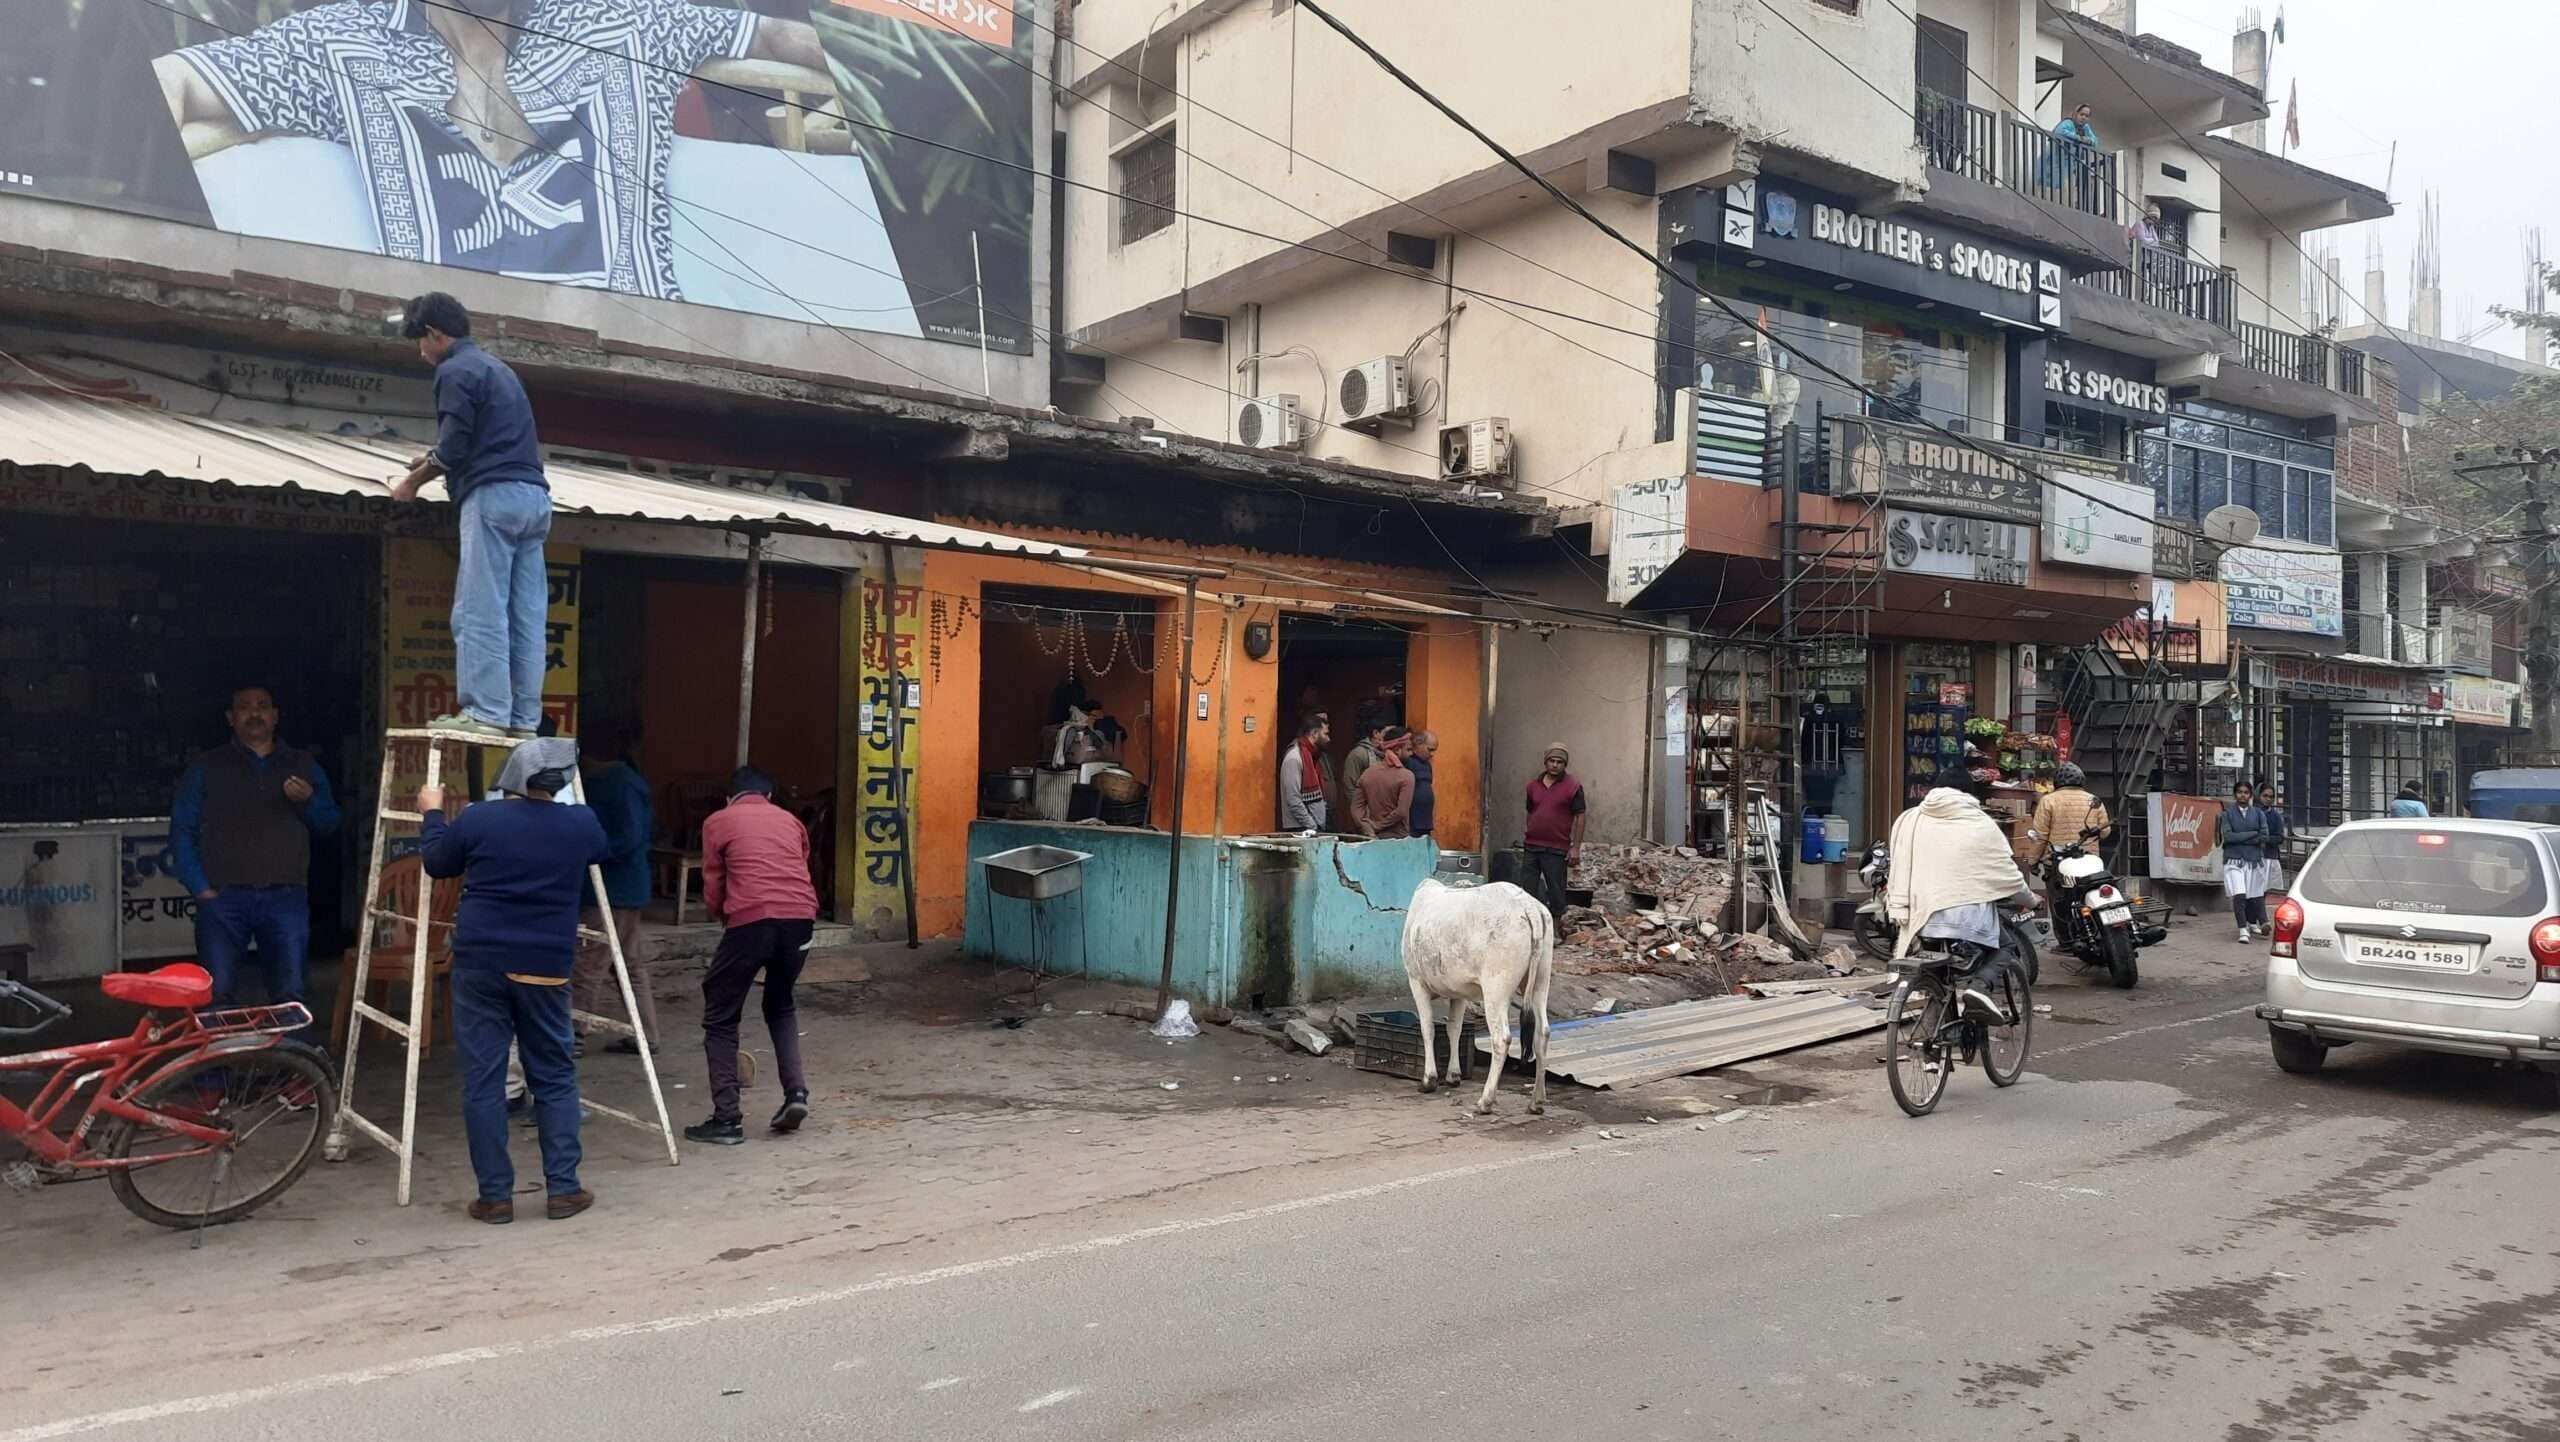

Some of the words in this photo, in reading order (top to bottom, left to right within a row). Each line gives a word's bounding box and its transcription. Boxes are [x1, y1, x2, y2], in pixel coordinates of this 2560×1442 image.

[1812, 202, 1944, 271] BROTHER's
[1950, 242, 2033, 294] SPORTS
[2084, 370, 2167, 415] SPORTS
[1908, 440, 2027, 484] BROTHER's
[1920, 512, 2017, 559] SAHELI
[2233, 613, 2254, 623] Cake
[2360, 945, 2417, 961] BR24Q
[2422, 951, 2465, 965] 1589
